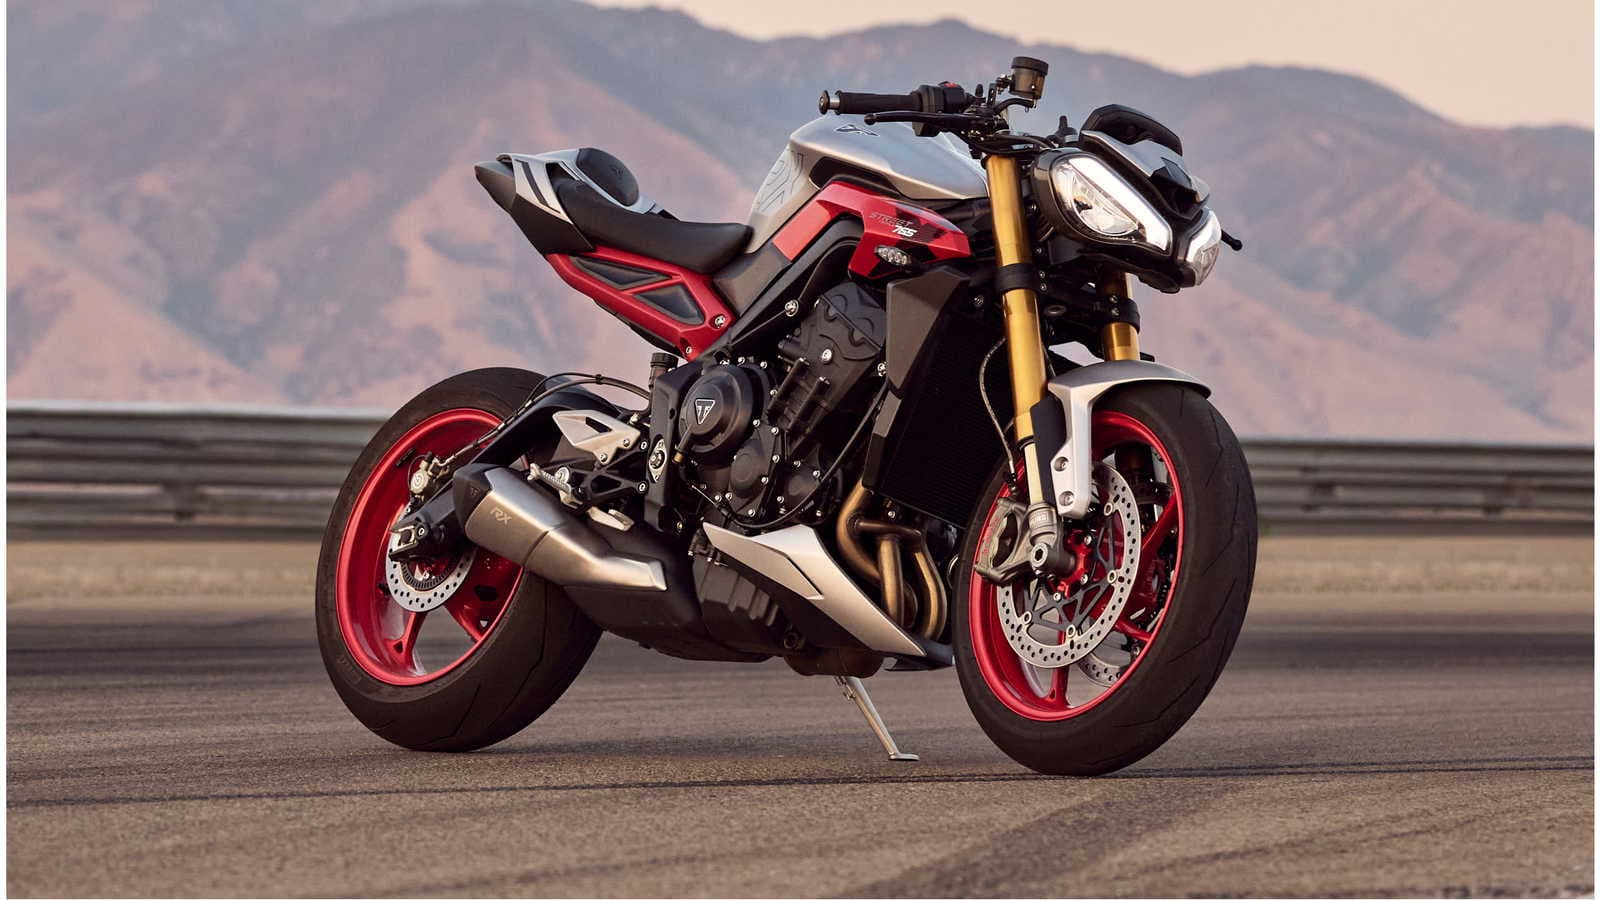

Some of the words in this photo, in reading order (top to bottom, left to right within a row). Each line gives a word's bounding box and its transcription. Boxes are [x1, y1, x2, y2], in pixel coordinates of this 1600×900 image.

[868, 211, 915, 228] STREET
[892, 224, 918, 238] 765
[490, 507, 512, 526] RX
